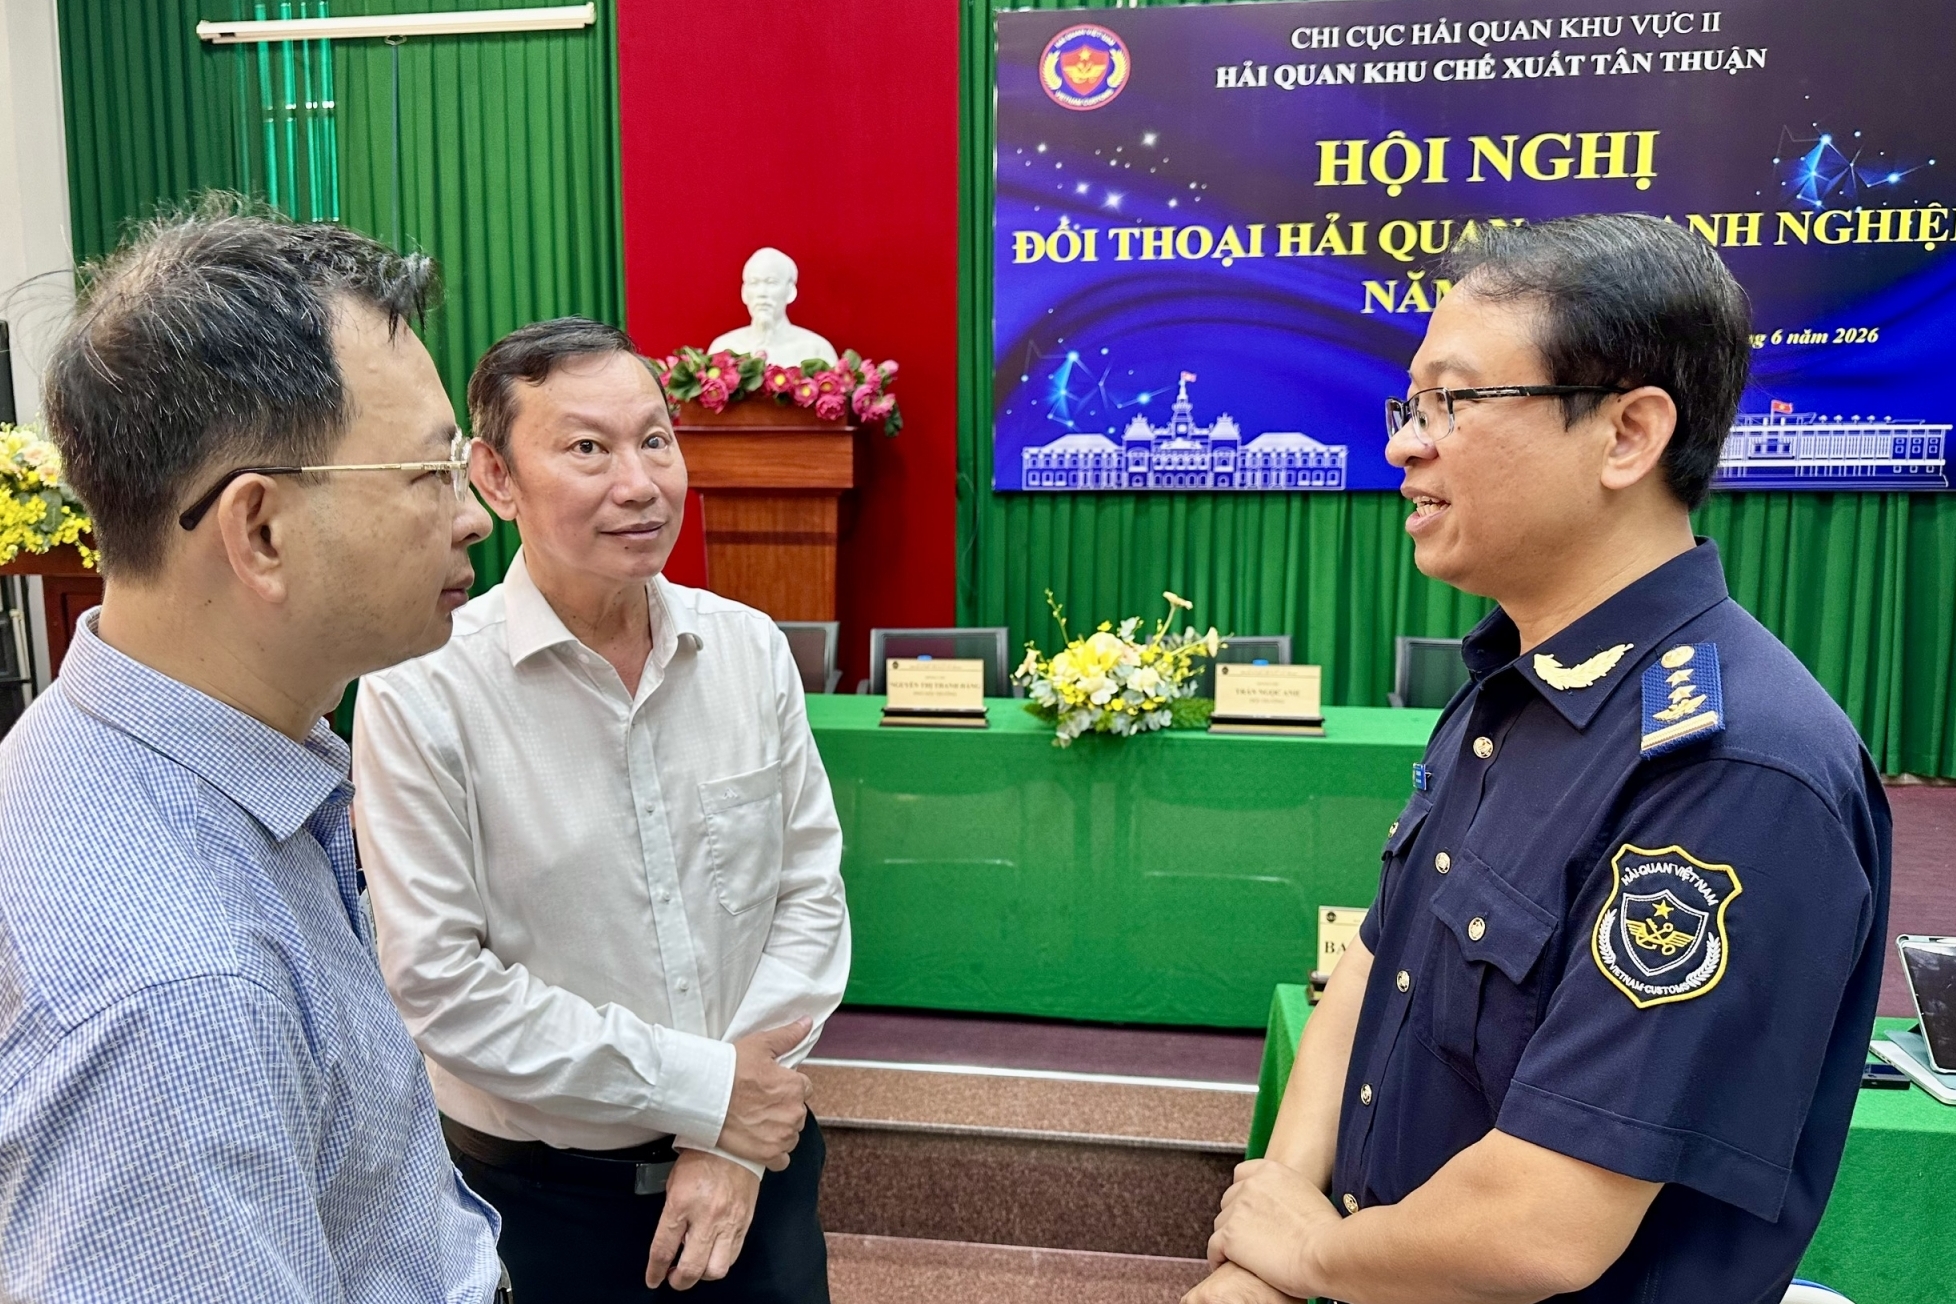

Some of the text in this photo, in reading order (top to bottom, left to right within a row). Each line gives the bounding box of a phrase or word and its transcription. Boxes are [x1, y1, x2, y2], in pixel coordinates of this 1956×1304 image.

[1291, 11, 1722, 50] CHI CỤC HẢI QUAN KHU VỰC II
[1215, 46, 1768, 90] HẢI QUAN KHU CHẾ XUẤT TÂN THUẬN
[1314, 130, 1661, 197] HỘI NGHỊ
[1108, 223, 1267, 268] THOẠI
[1275, 212, 1369, 257] HẢI
[1378, 217, 1526, 262] QUA
[1774, 202, 1956, 251] NGHIỆ
[1770, 328, 1784, 345] 6
[1786, 328, 1829, 345] năm
[1832, 327, 1880, 344] 2026
[1620, 862, 1719, 907] HẢI QUAN VIỆT NAM
[1609, 962, 1690, 995] VIETNAM CUSTOMS
